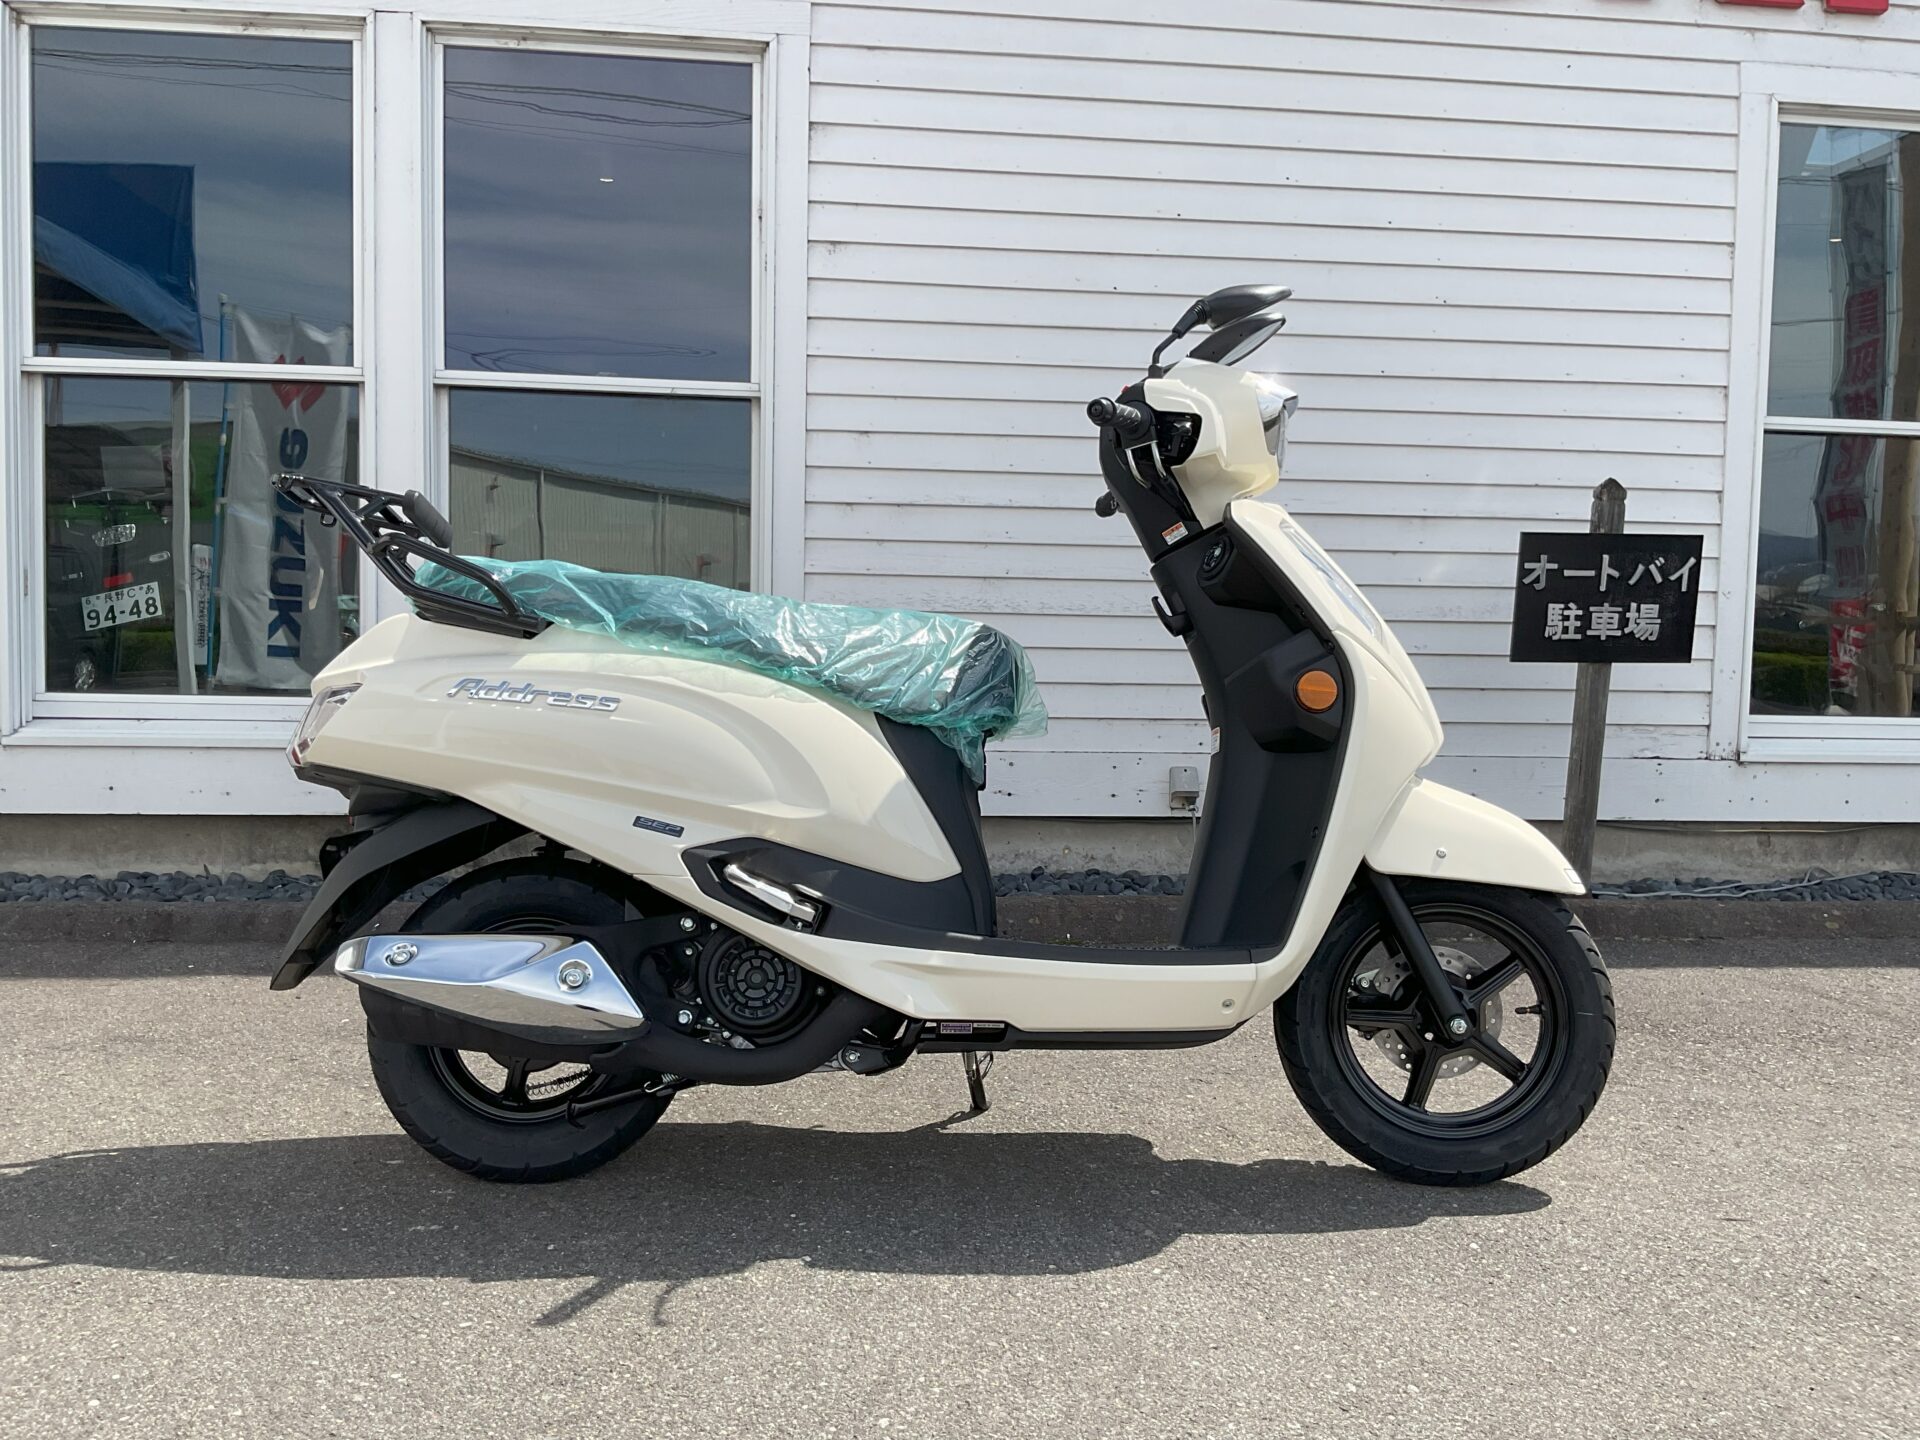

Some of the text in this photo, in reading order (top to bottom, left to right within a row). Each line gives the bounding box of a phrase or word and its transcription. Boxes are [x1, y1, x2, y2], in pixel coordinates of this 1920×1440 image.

[145, 584, 155, 595] あ
[1521, 553, 1697, 593] オートバイ
[86, 597, 158, 628] 94-48
[1544, 602, 1662, 641] 駐車場
[447, 678, 621, 711] Address
